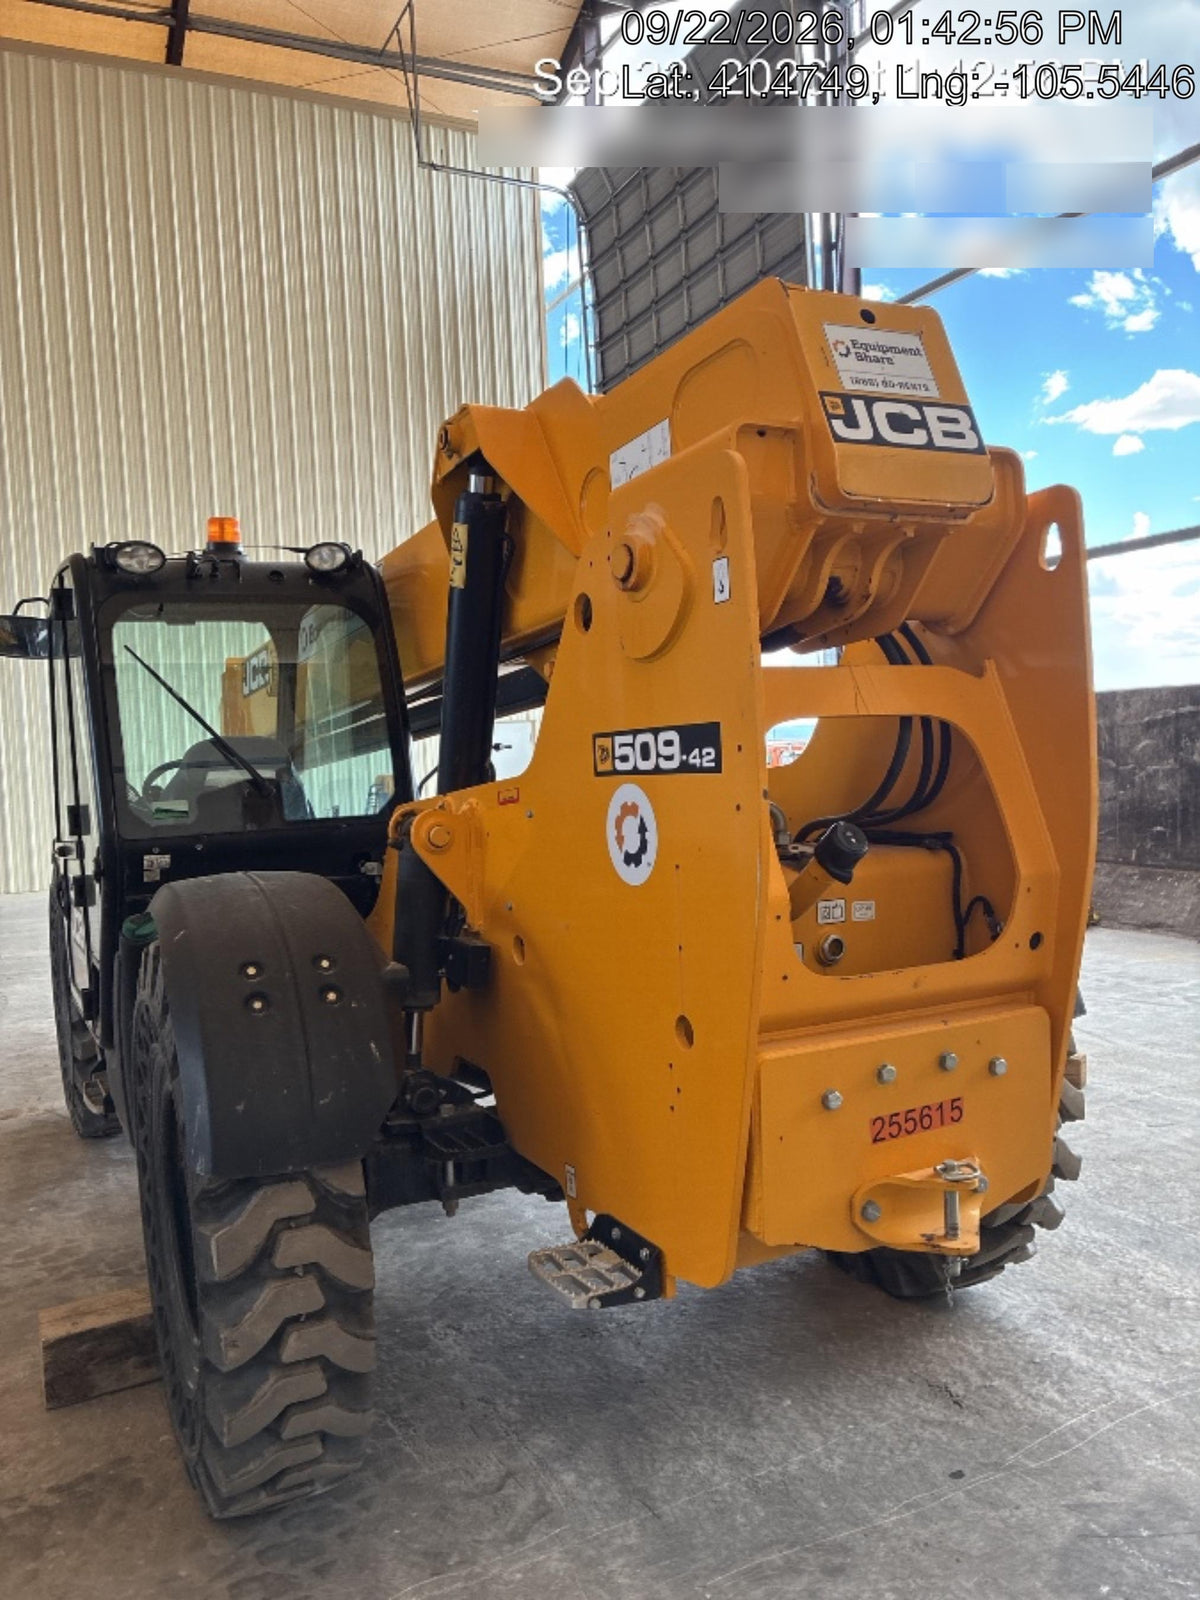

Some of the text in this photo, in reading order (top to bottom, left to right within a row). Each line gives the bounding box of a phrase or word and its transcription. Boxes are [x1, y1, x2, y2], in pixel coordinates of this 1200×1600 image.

[849, 339, 923, 358] Equipment
[855, 351, 895, 366] Share
[831, 398, 979, 449] JCB
[871, 1096, 964, 1144] 255615
